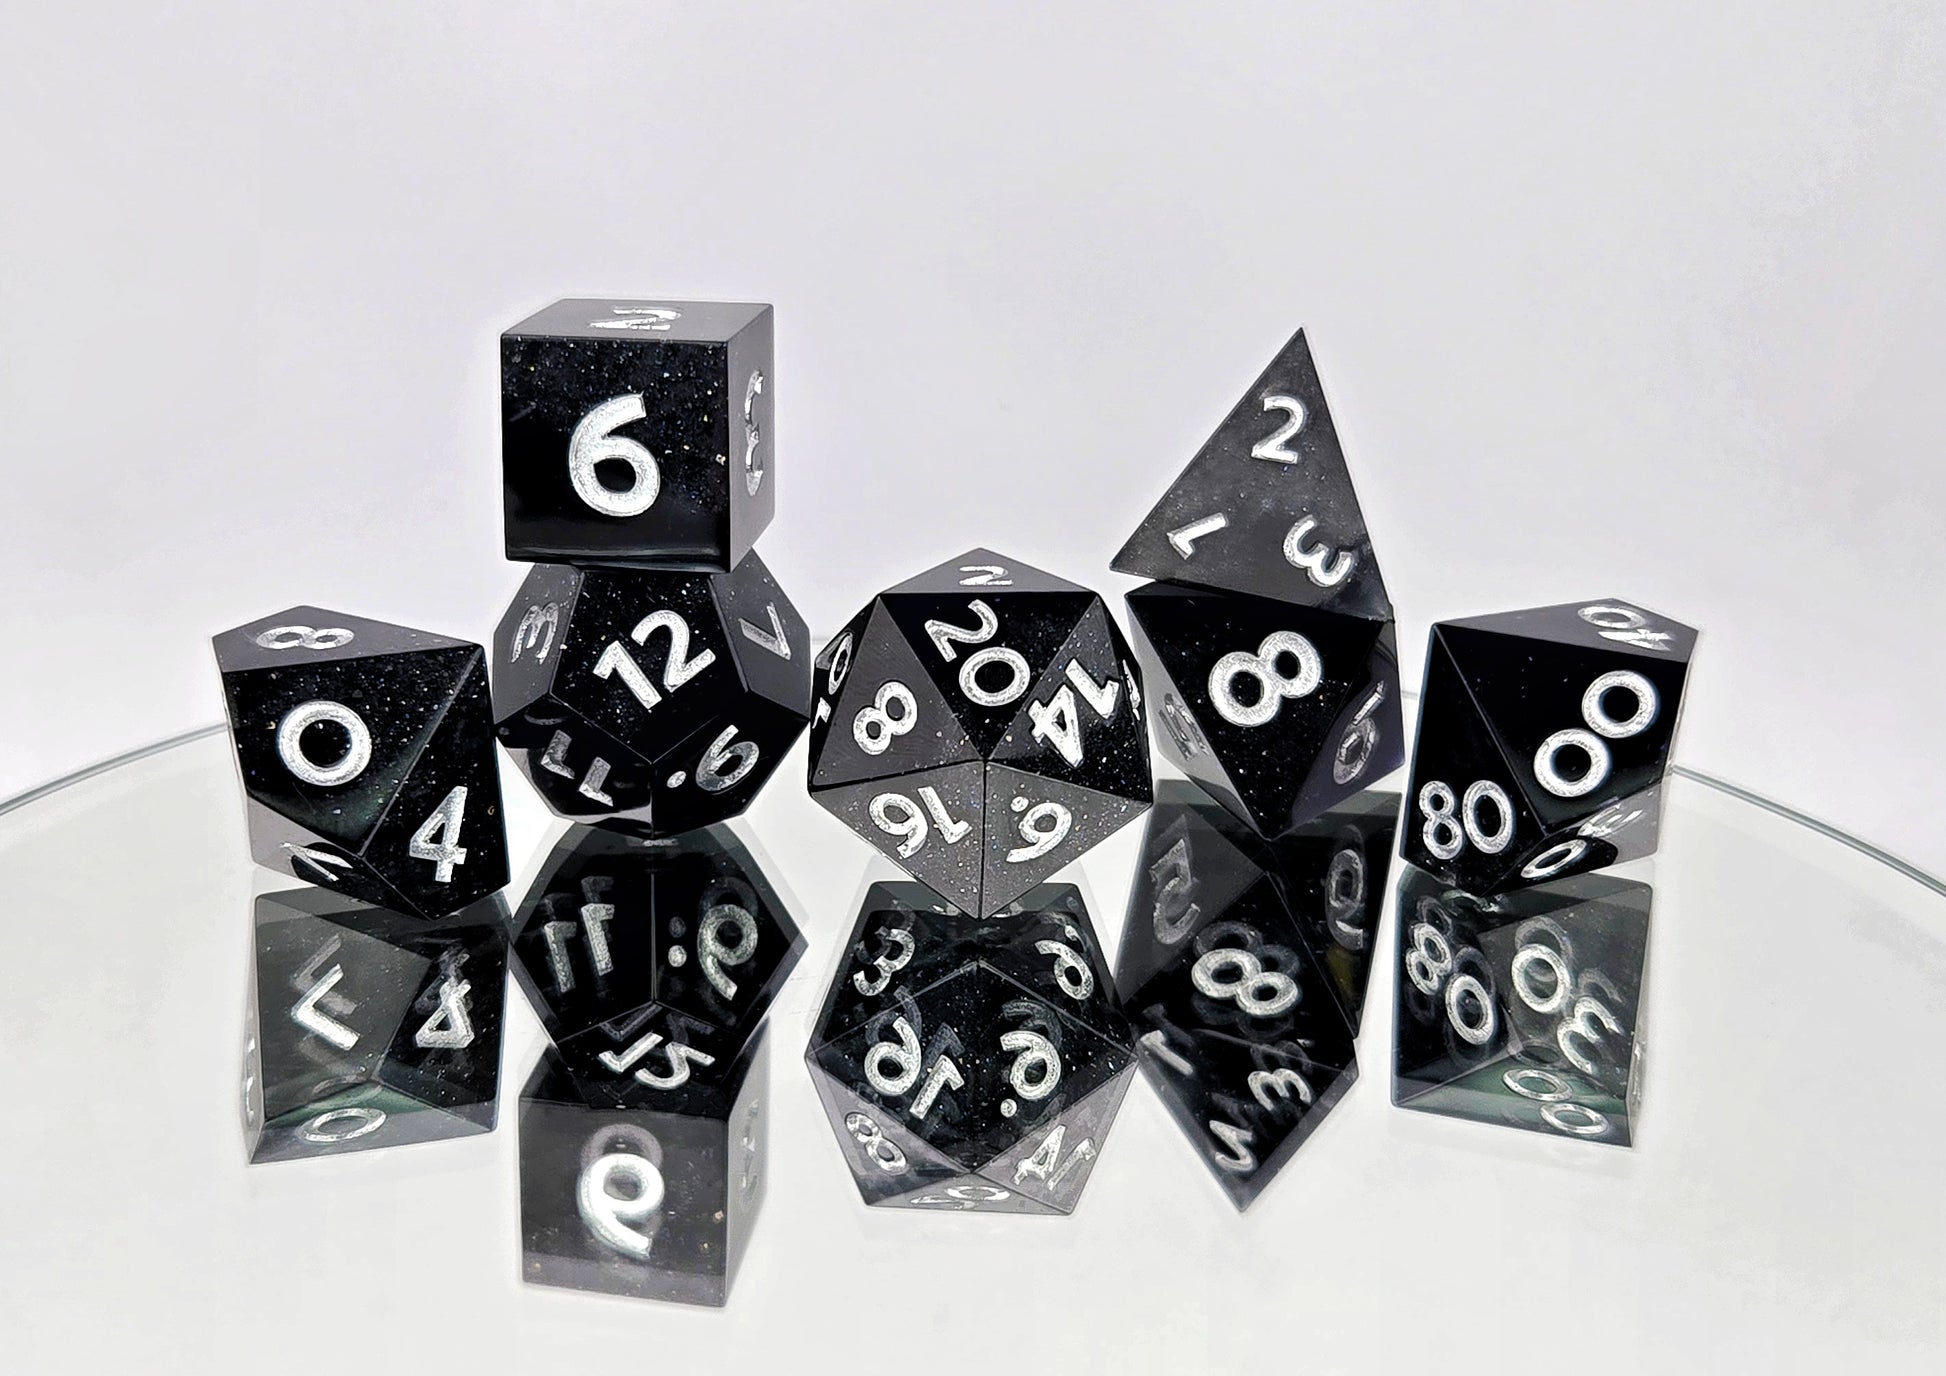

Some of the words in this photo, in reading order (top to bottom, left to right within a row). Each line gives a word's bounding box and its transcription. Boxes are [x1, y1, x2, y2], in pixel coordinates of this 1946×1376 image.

[568, 392, 661, 517] 6
[1251, 395, 1308, 465] 2
[1283, 515, 1355, 588] 3
[256, 625, 355, 651] 8
[510, 601, 560, 665] 3
[593, 609, 717, 710] 12
[924, 599, 1031, 707] 20
[853, 680, 919, 756] 8
[1028, 657, 1110, 769] 14
[1207, 630, 1322, 728] 8
[279, 700, 373, 787] 0
[1533, 670, 1661, 798] 00
[409, 785, 468, 883] 4
[867, 786, 973, 859] 16
[1418, 779, 1515, 861] 80
